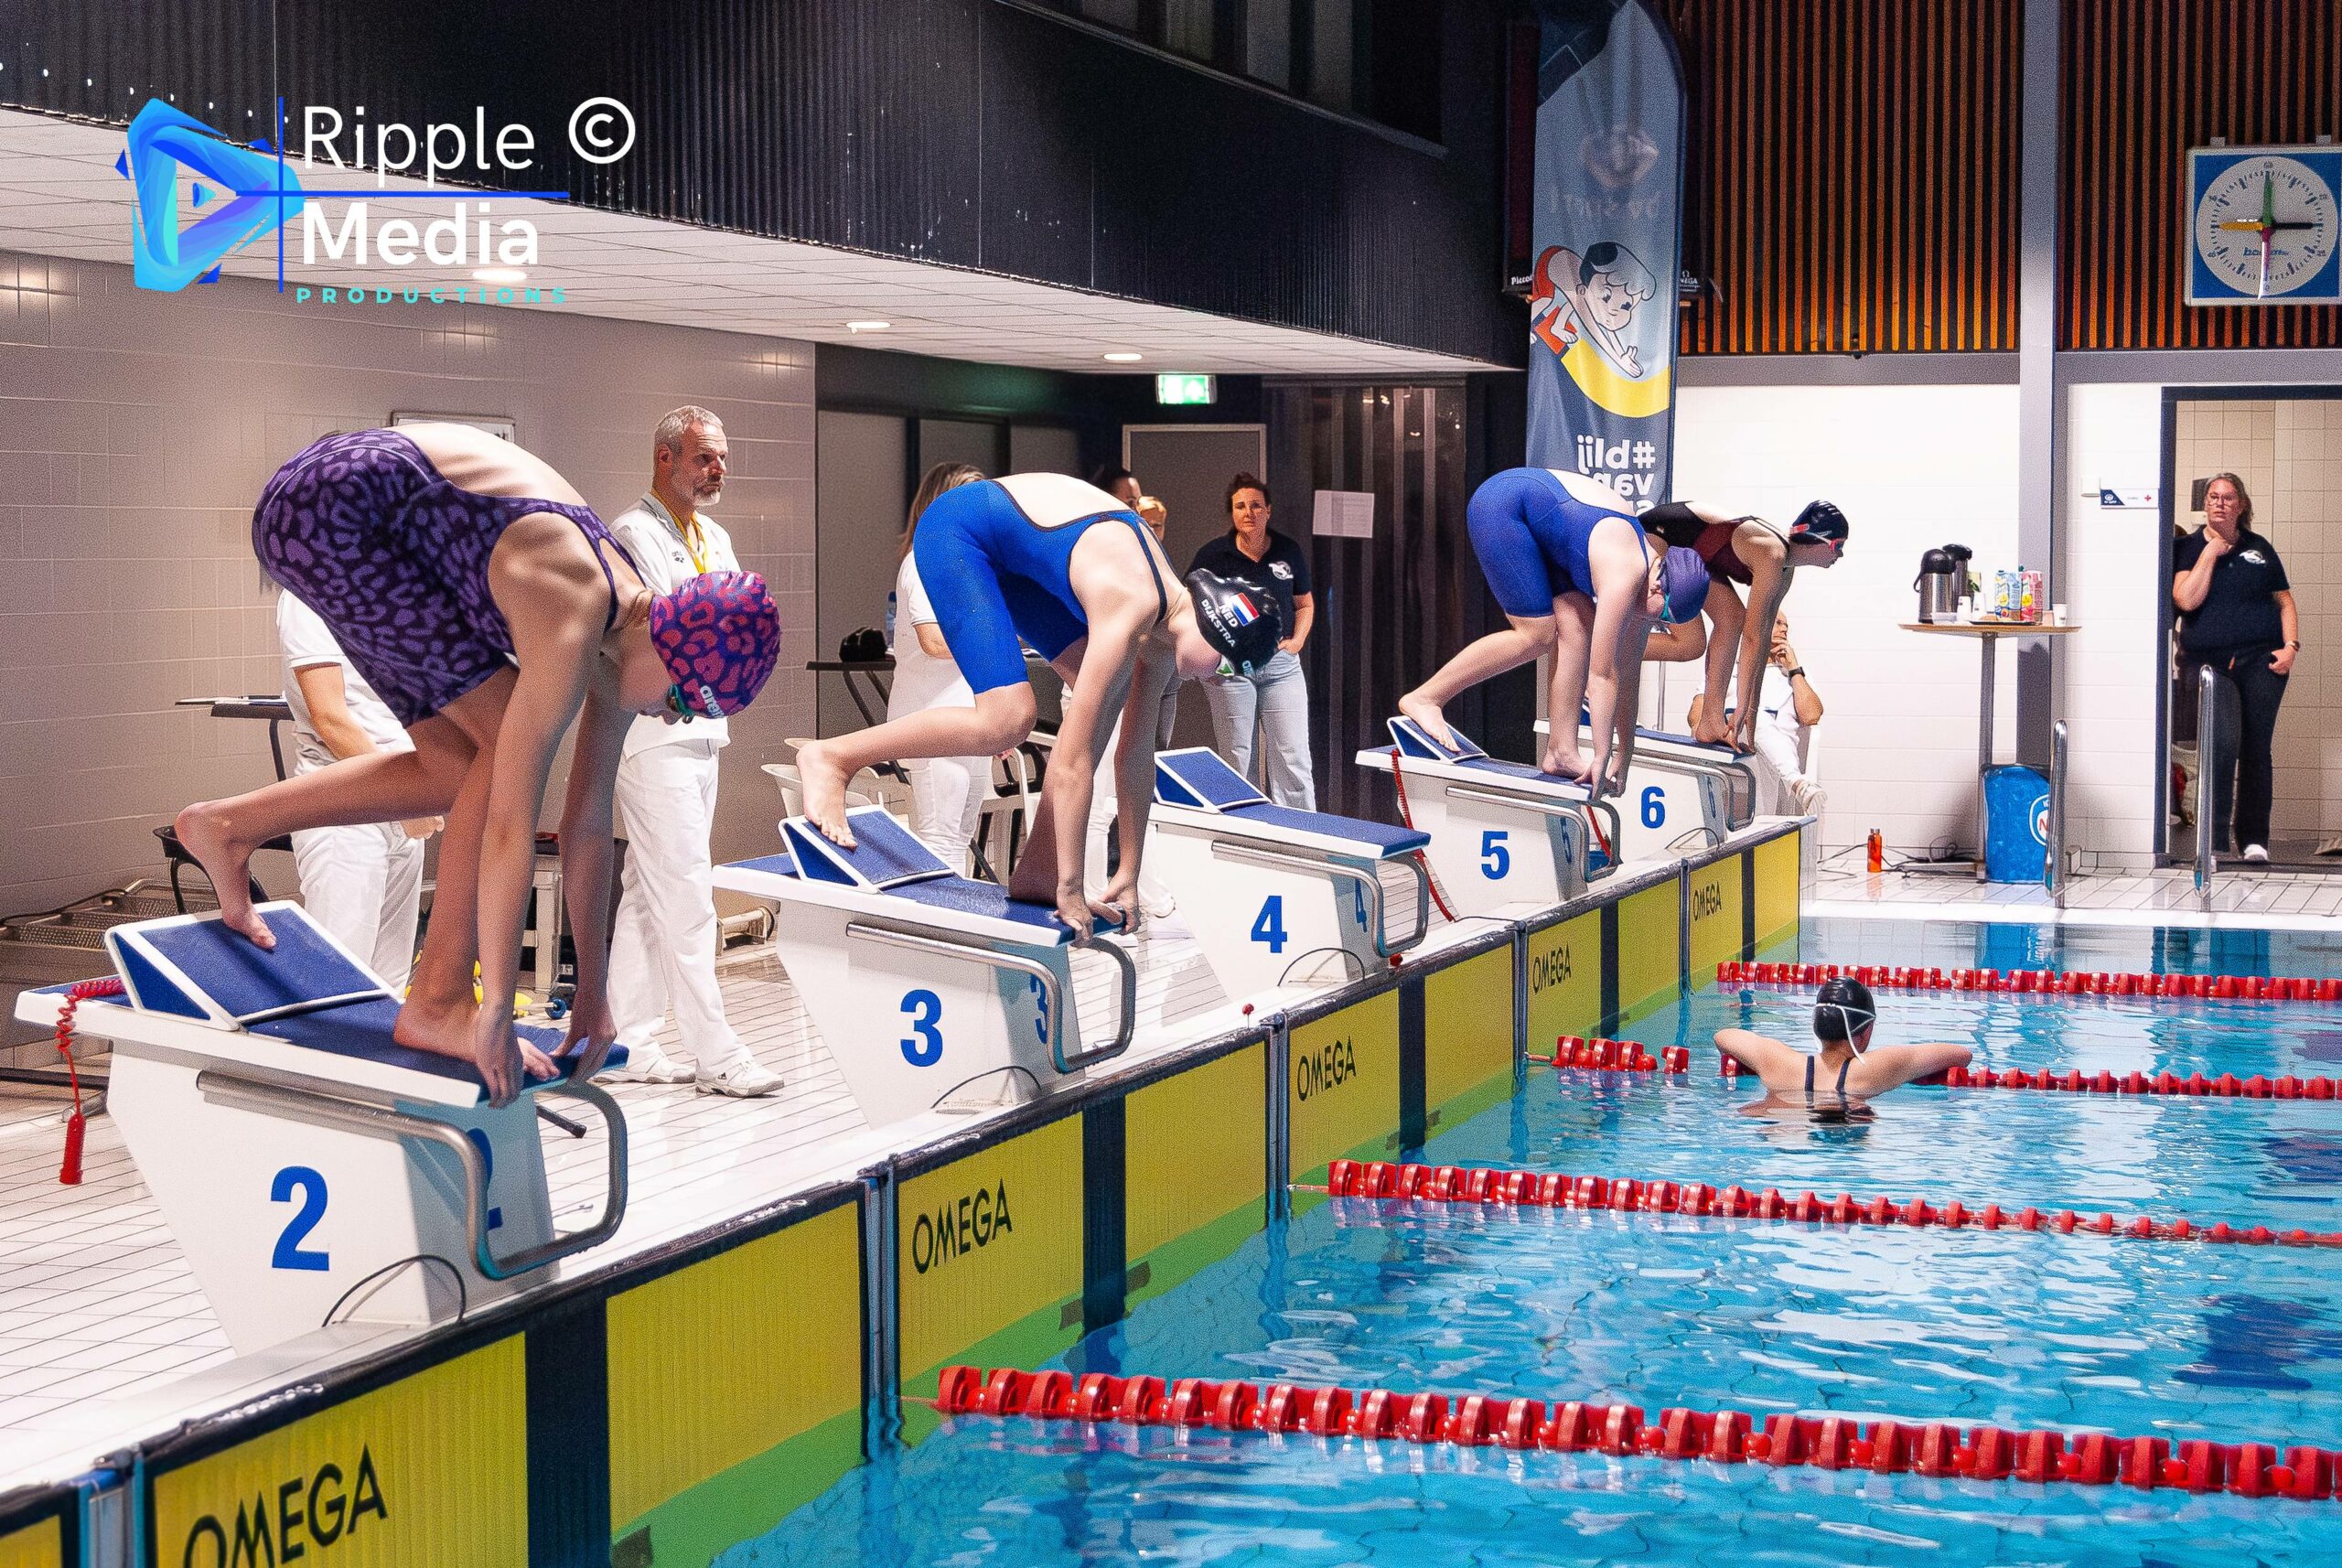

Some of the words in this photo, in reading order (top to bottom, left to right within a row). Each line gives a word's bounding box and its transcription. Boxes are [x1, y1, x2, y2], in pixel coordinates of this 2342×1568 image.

[1201, 599, 1236, 648] DIJKSTRA
[1219, 604, 1238, 628] NED
[1641, 786, 1665, 829] 6
[1481, 831, 1510, 880] 5
[1252, 896, 1287, 953] 4
[1355, 878, 1368, 933] 4
[1692, 882, 1722, 921] OMEGA
[1532, 942, 1572, 993] OMEGA
[899, 989, 943, 1067] 3
[1030, 973, 1048, 1044] 3
[1297, 1033, 1357, 1101] OMEGA
[271, 1165, 329, 1271] 2
[912, 1176, 1013, 1274] OMEGA
[183, 1442, 388, 1568] OMEGA
